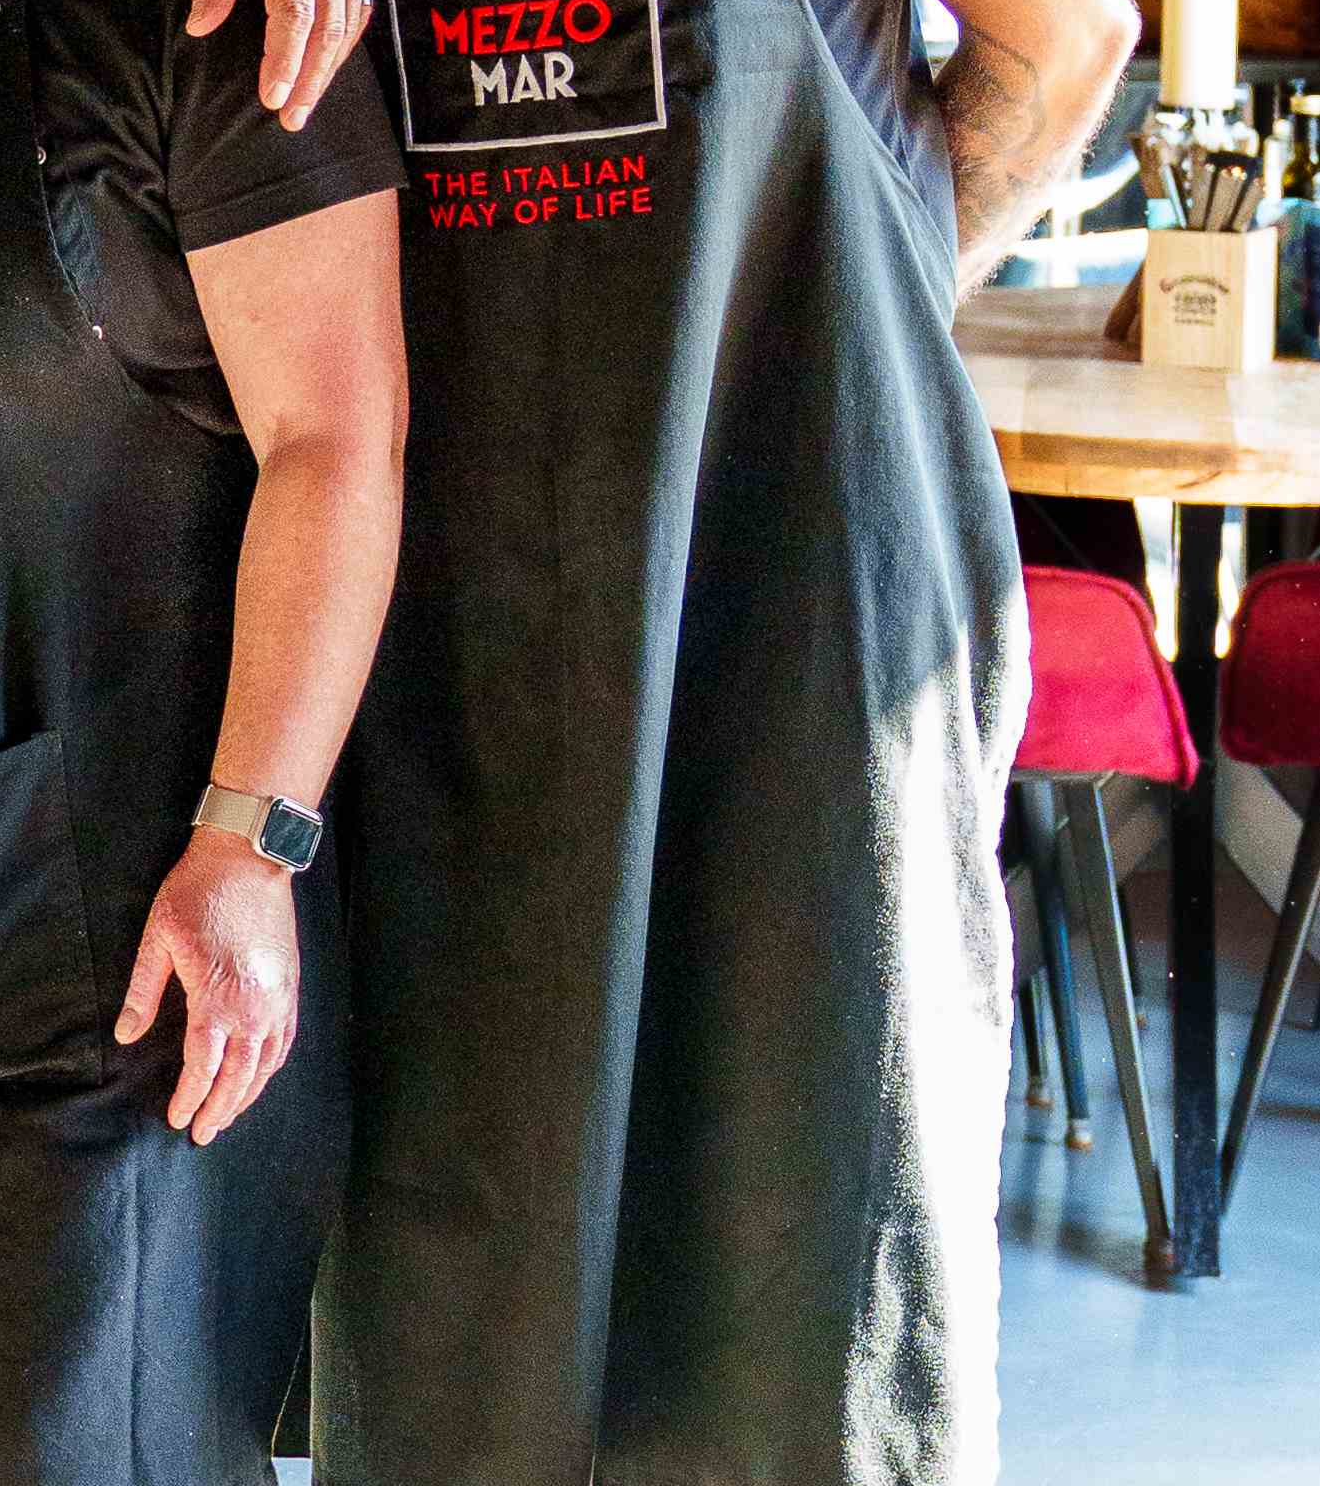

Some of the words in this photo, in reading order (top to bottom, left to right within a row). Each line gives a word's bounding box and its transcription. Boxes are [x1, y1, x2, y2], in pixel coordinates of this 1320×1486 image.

[471, 52, 578, 107] MAR
[424, 171, 488, 197] THE
[502, 155, 646, 193] ITALIAN
[430, 201, 497, 228] WAY
[513, 196, 559, 225] OF
[574, 186, 652, 221] LIFE
